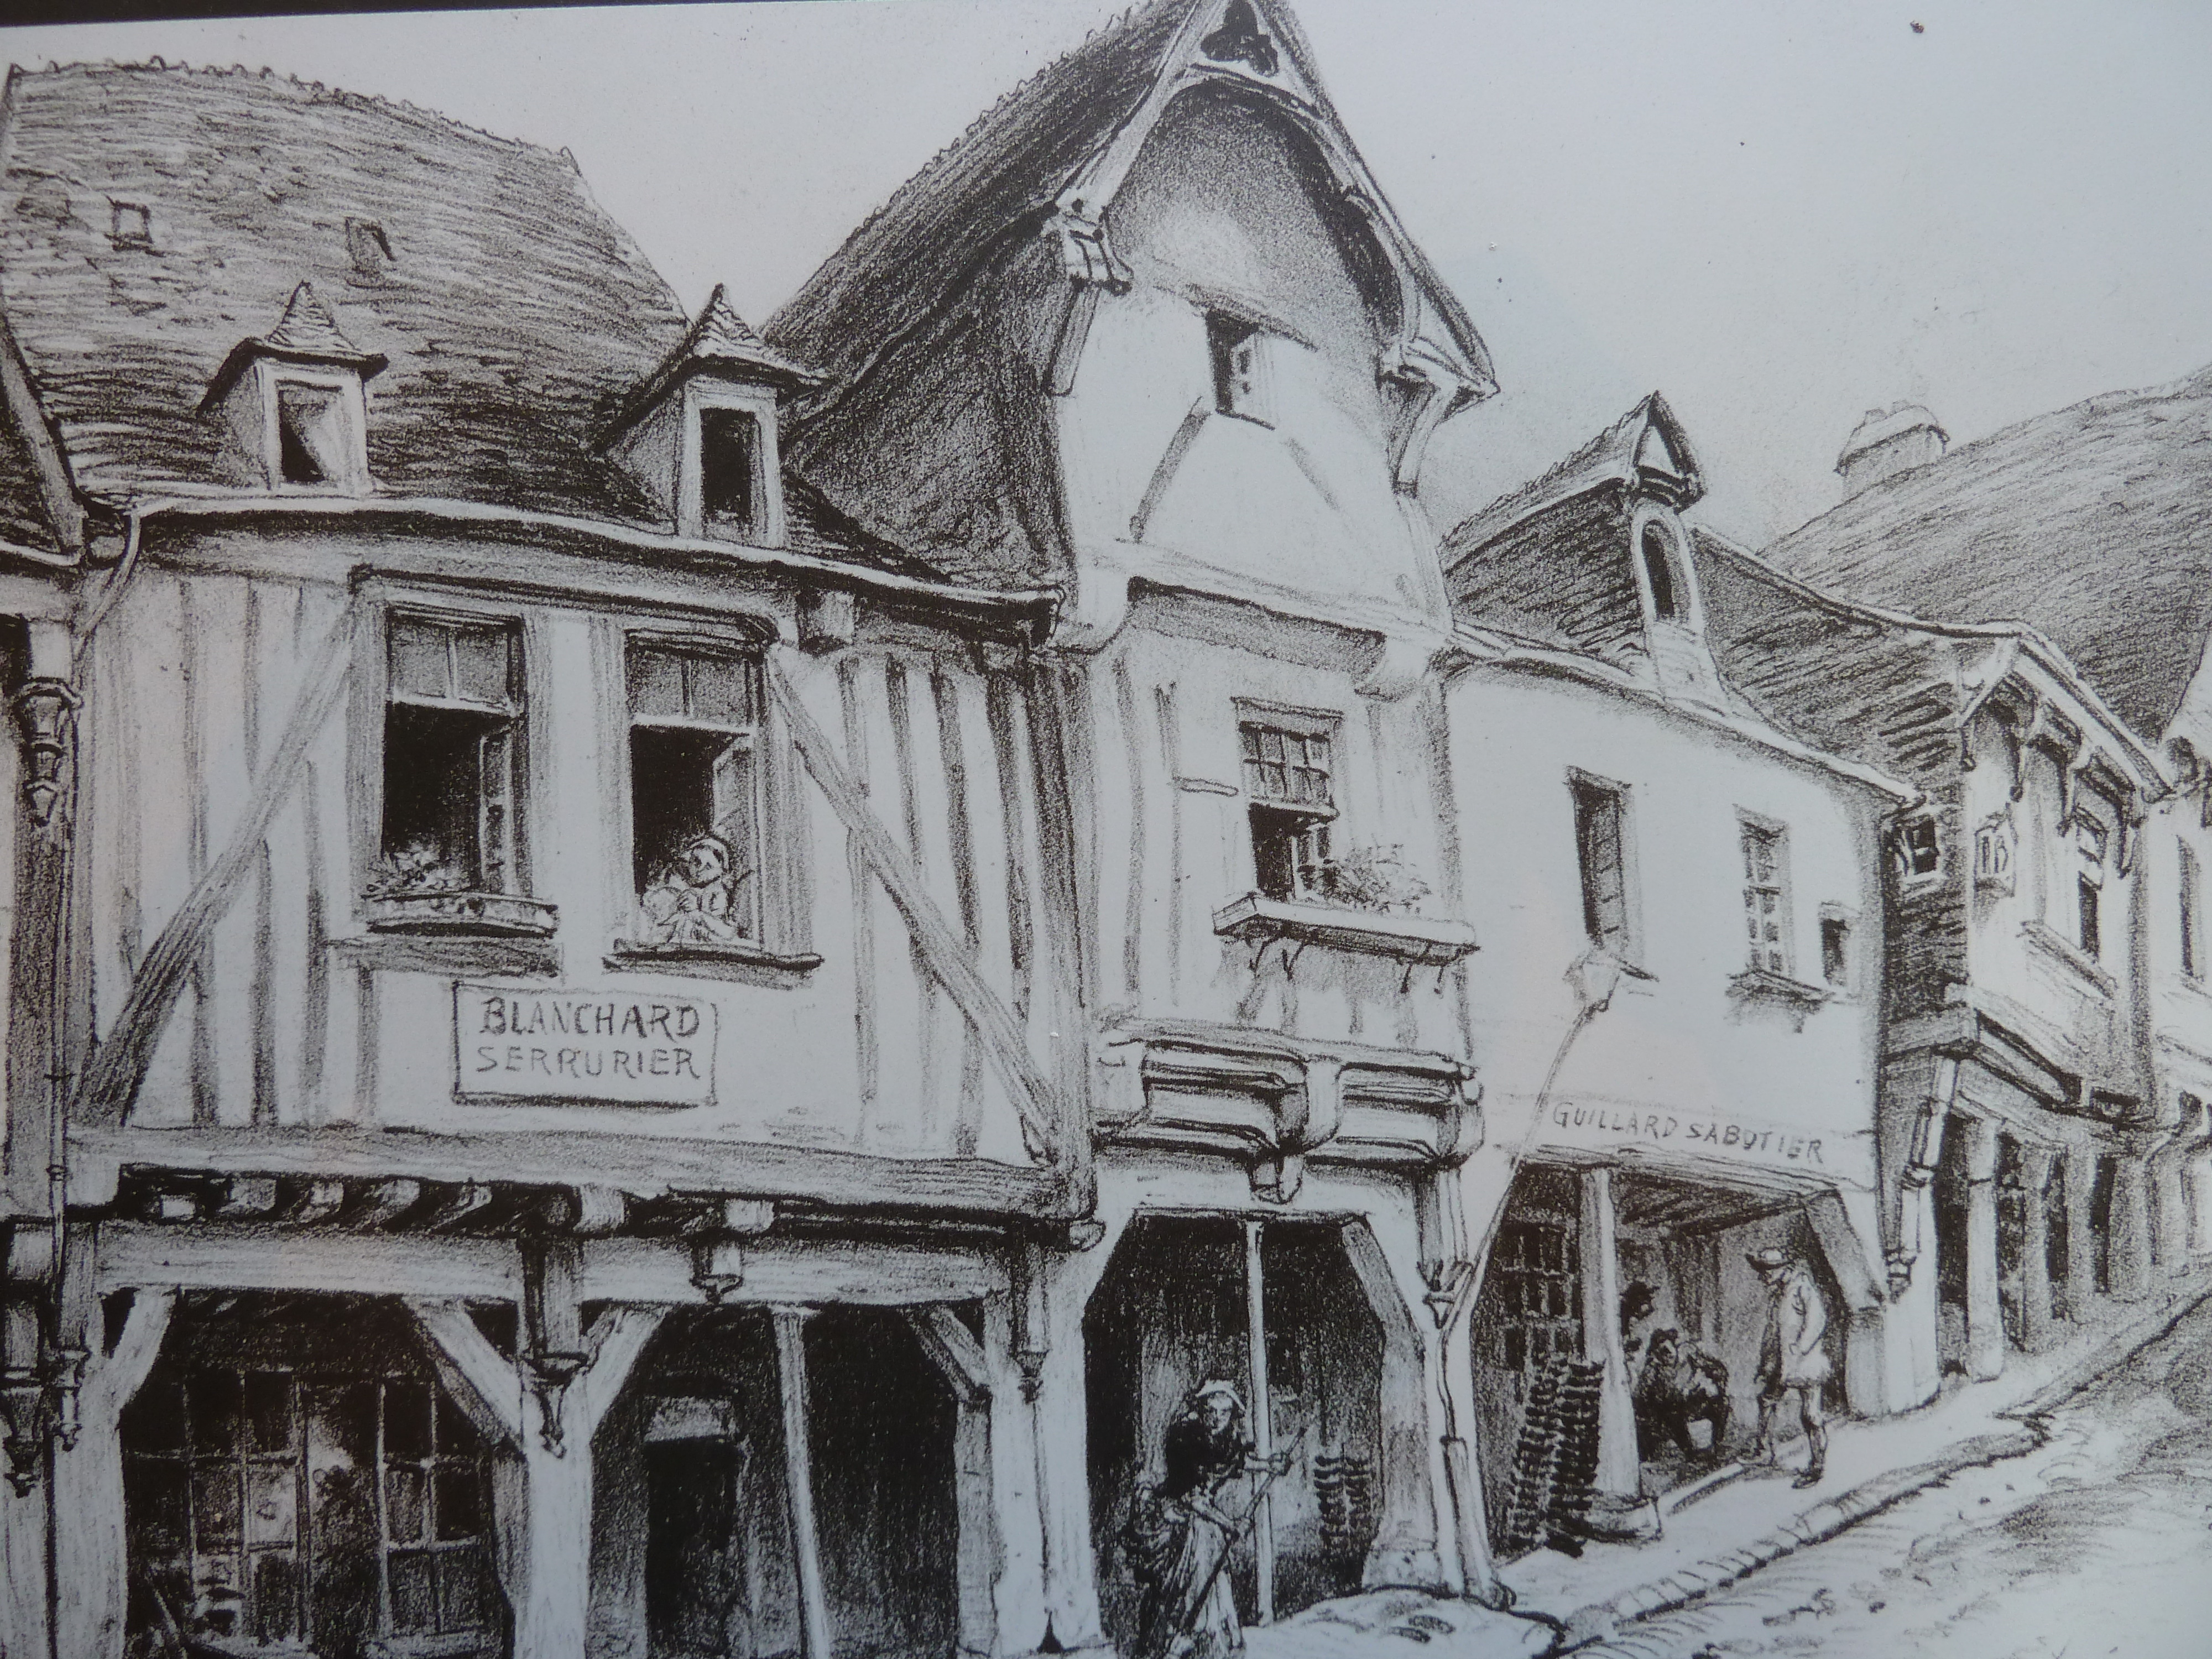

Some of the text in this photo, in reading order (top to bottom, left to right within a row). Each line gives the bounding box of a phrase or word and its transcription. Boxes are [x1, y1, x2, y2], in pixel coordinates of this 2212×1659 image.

[479, 996, 700, 1043] BLANCHARD
[476, 1046, 701, 1079] SERRURIER
[1553, 1102, 1678, 1139] GUILLARD
